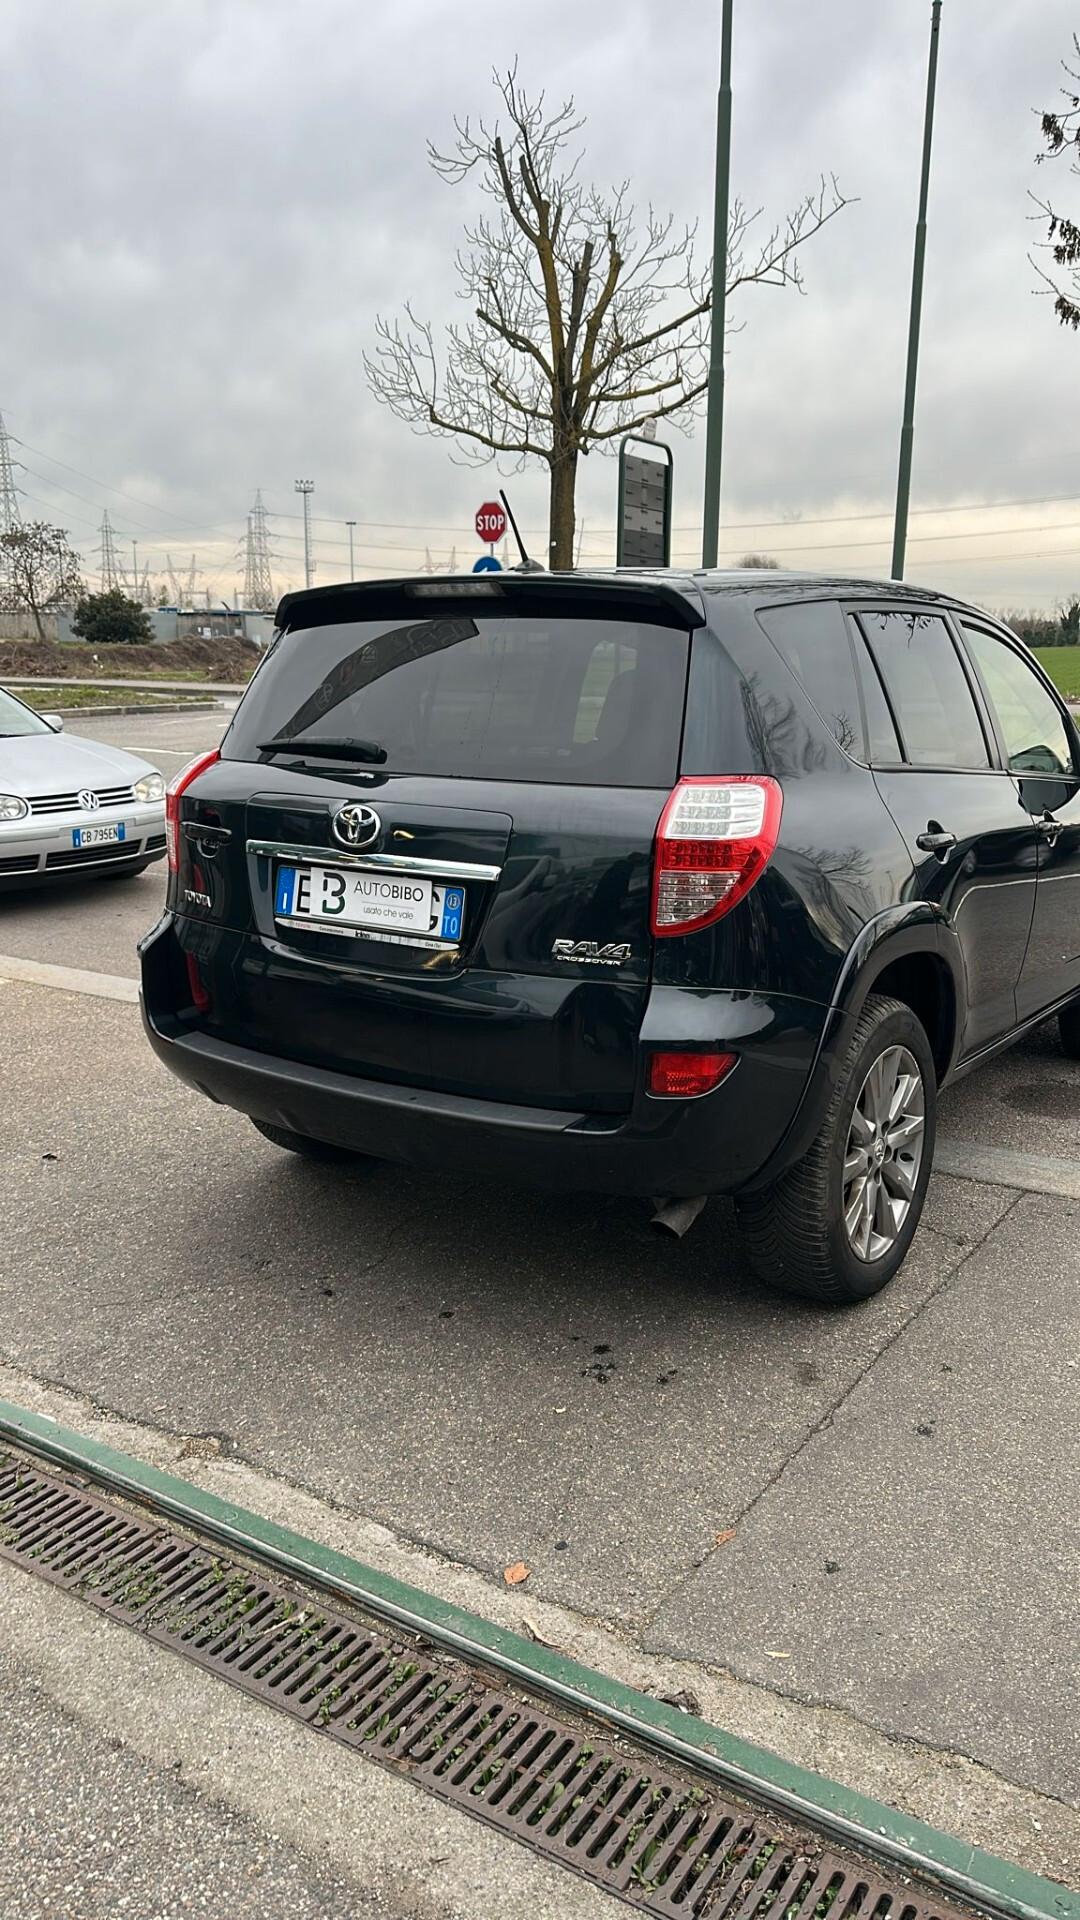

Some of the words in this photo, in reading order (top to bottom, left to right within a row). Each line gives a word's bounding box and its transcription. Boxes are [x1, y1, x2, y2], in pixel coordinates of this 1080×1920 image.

[477, 515, 505, 531] STOP
[81, 831, 92, 843] CB
[353, 880, 424, 902] AUTOBIBO
[363, 906, 383, 917] usato
[383, 908, 397, 918] che
[398, 909, 414, 920] vale
[444, 915, 458, 935] TO
[552, 938, 632, 960] RAV4
[557, 955, 623, 966] CROSSOVER
